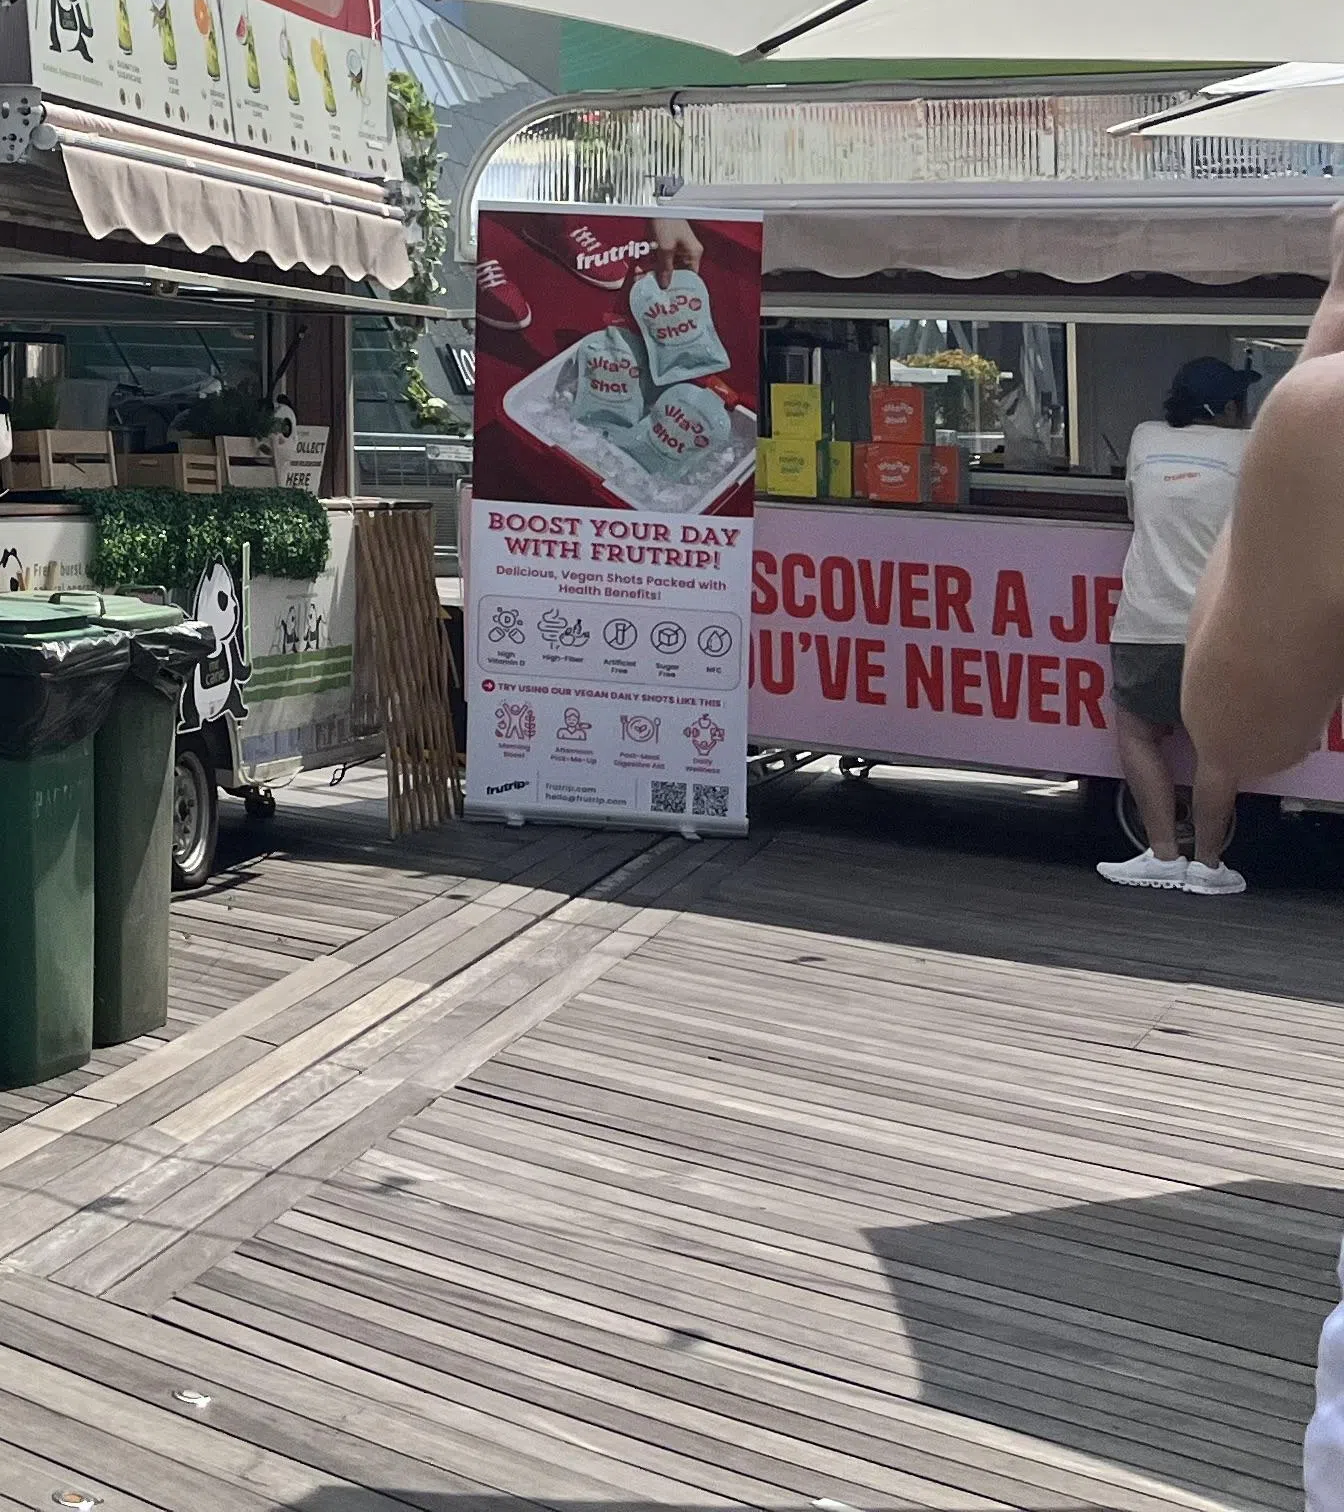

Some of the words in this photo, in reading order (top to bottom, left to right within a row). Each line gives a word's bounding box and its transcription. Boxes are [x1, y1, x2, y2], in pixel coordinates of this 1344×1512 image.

[286, 472, 311, 487] HERE
[488, 511, 582, 537] BOOST
[590, 519, 672, 543] YOUR
[681, 525, 741, 547] DAY
[504, 536, 581, 560] WITH
[591, 542, 722, 570] FRUTRIP!
[496, 565, 558, 580] Delicious,
[562, 570, 603, 585] Vegan
[607, 573, 643, 586] Shots
[646, 576, 696, 589] Packed
[698, 579, 727, 591] with
[559, 584, 602, 596] Health
[992, 570, 1033, 639] A
[499, 682, 517, 691] TRY
[518, 684, 549, 694] USING
[551, 686, 572, 696] OUR
[574, 688, 609, 699] VEGAN
[611, 691, 639, 701] DAILY
[905, 643, 1108, 729] NEVER
